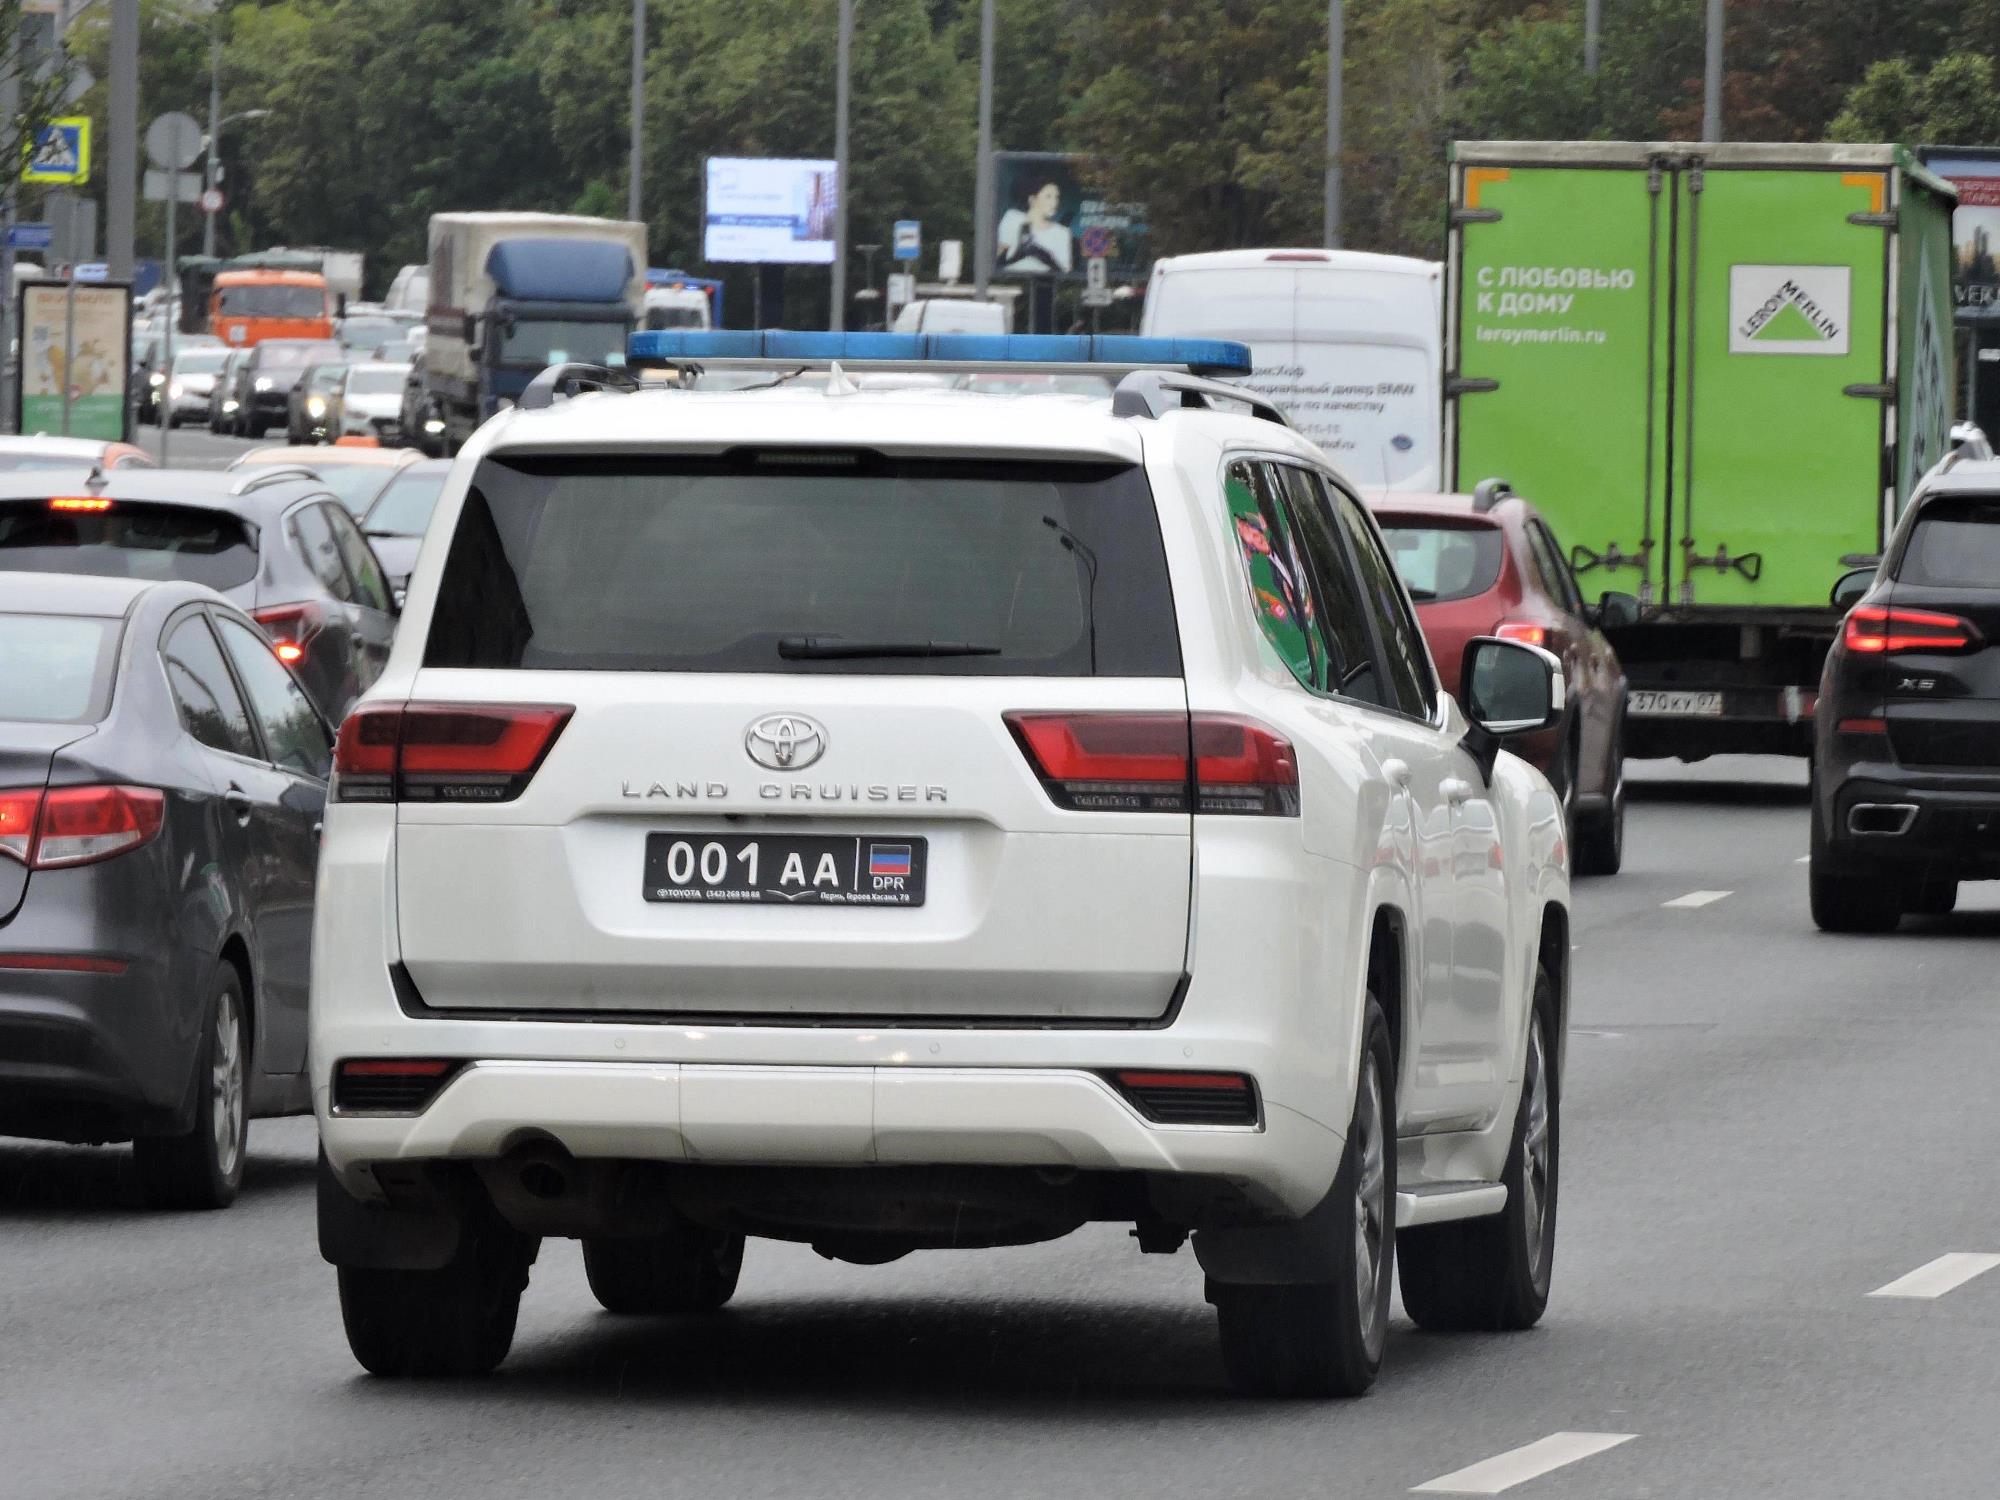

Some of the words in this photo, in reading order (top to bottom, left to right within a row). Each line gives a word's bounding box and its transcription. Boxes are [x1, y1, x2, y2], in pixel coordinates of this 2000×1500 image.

[1477, 266, 1495, 288] С
[1498, 267, 1635, 289] ЛЮБОВЬЮ
[1476, 292, 1494, 313] К
[1497, 293, 1574, 317] ДОМУ
[1739, 286, 1787, 338] LEROY
[1781, 279, 1840, 339] MERLIN
[1476, 325, 1606, 345] leroymerlin.ru
[622, 780, 728, 799] LAND
[759, 783, 948, 802] CRUISER
[667, 841, 760, 886] 001
[668, 889, 701, 898] TOYOTA
[873, 876, 905, 891] DPR
